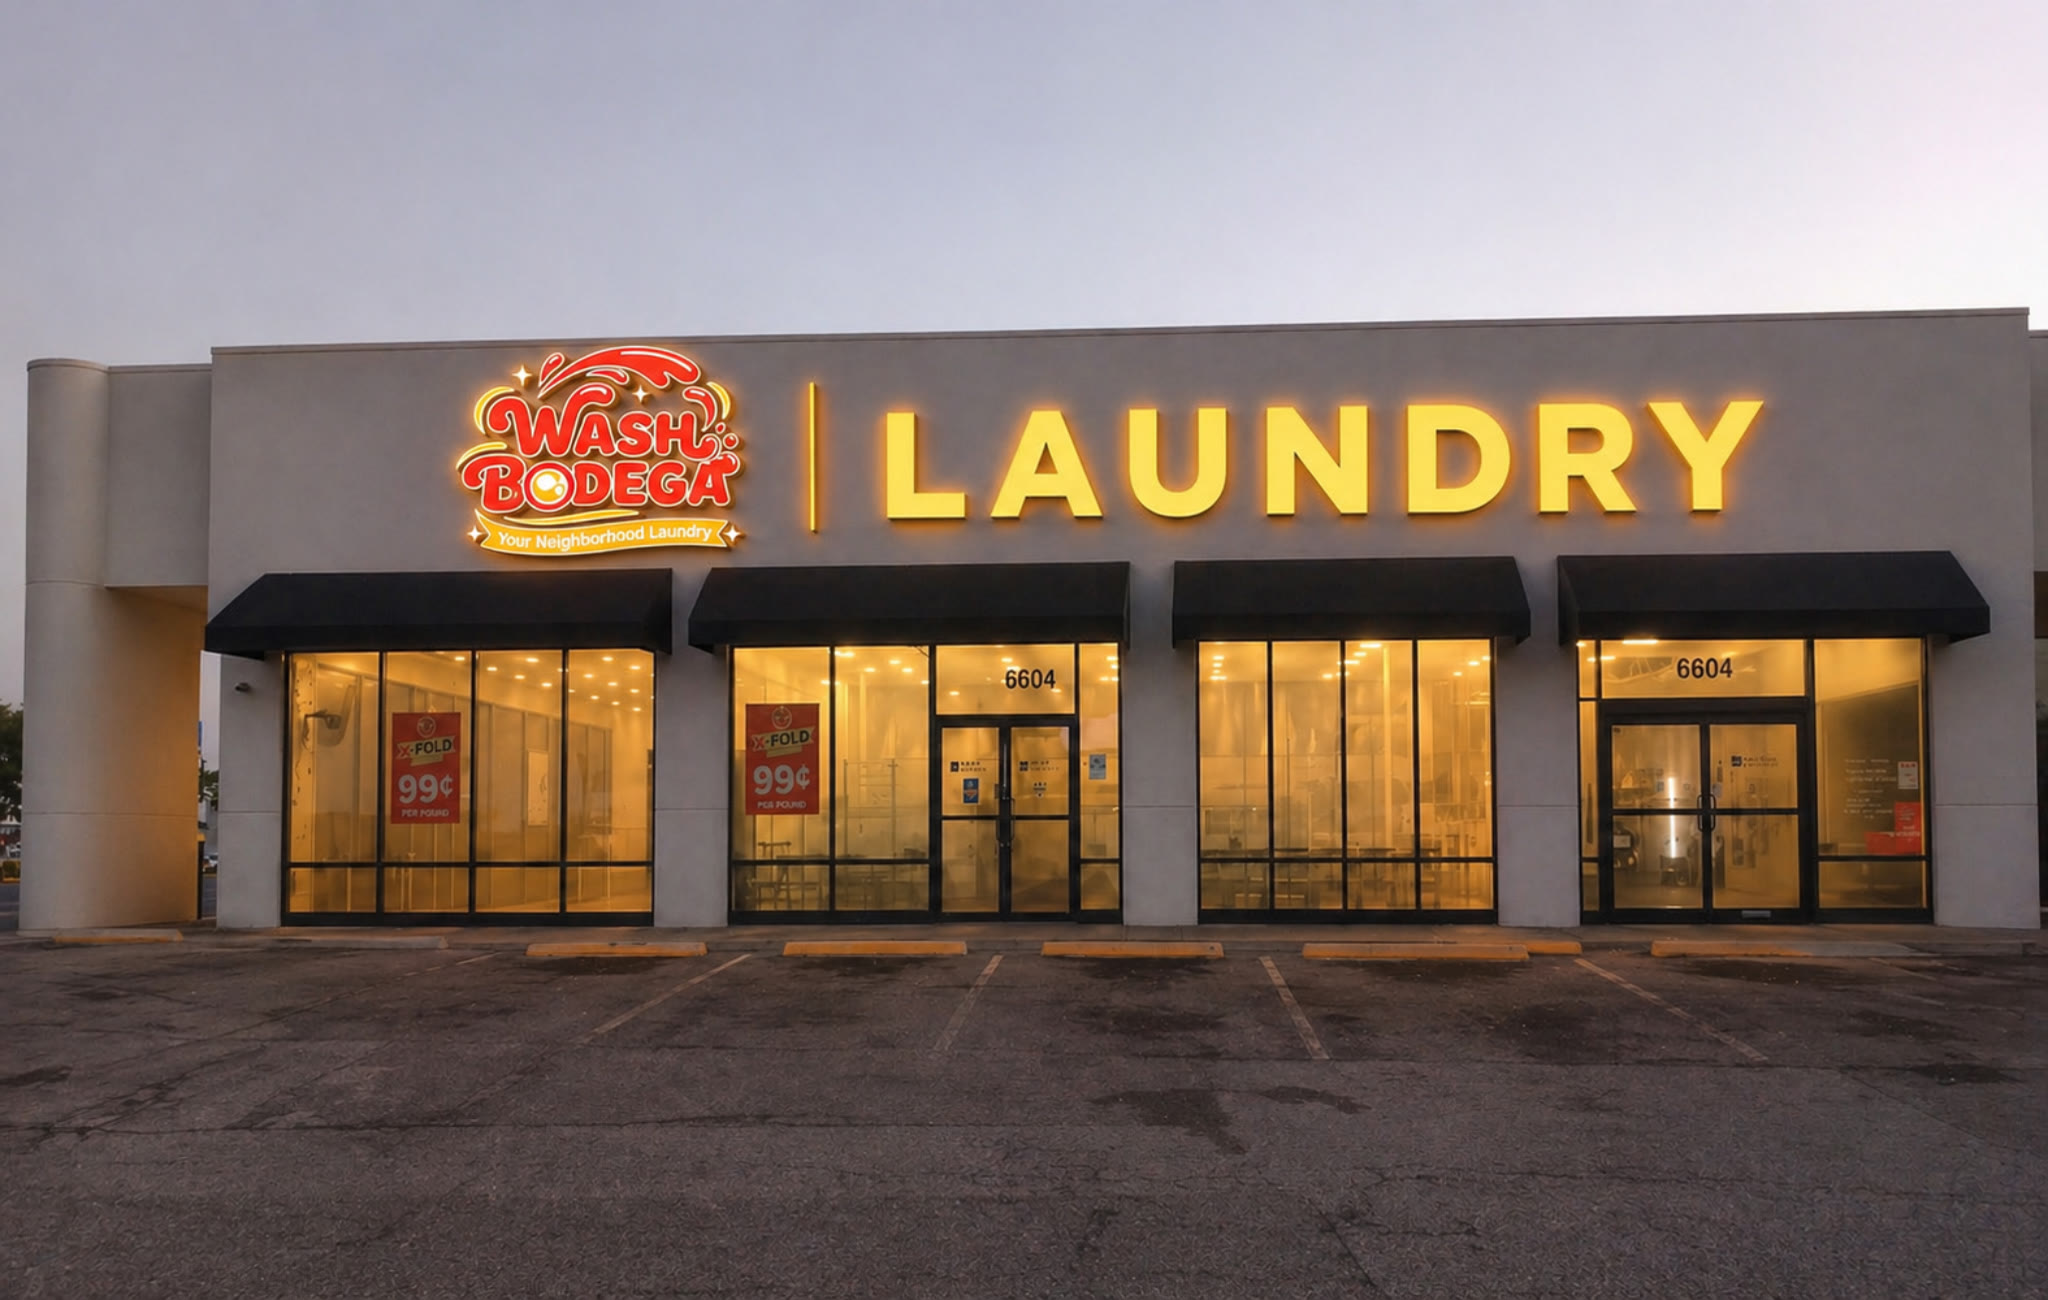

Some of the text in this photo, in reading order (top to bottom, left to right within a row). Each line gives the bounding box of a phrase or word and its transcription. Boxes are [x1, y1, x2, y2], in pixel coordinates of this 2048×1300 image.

[487, 382, 721, 461] WASH
[886, 400, 1765, 519] LAUNDRY
[462, 453, 741, 513] BODEGA
[498, 524, 713, 552] Your Neighborhood Laundry
[1005, 669, 1056, 689] 6604
[1677, 657, 1733, 679] 6604
[399, 739, 452, 757] X-FOLD
[754, 730, 810, 751] X-FOLD
[398, 773, 454, 804] 99¢
[753, 764, 811, 796] 99¢
[401, 809, 450, 817] PER POUND
